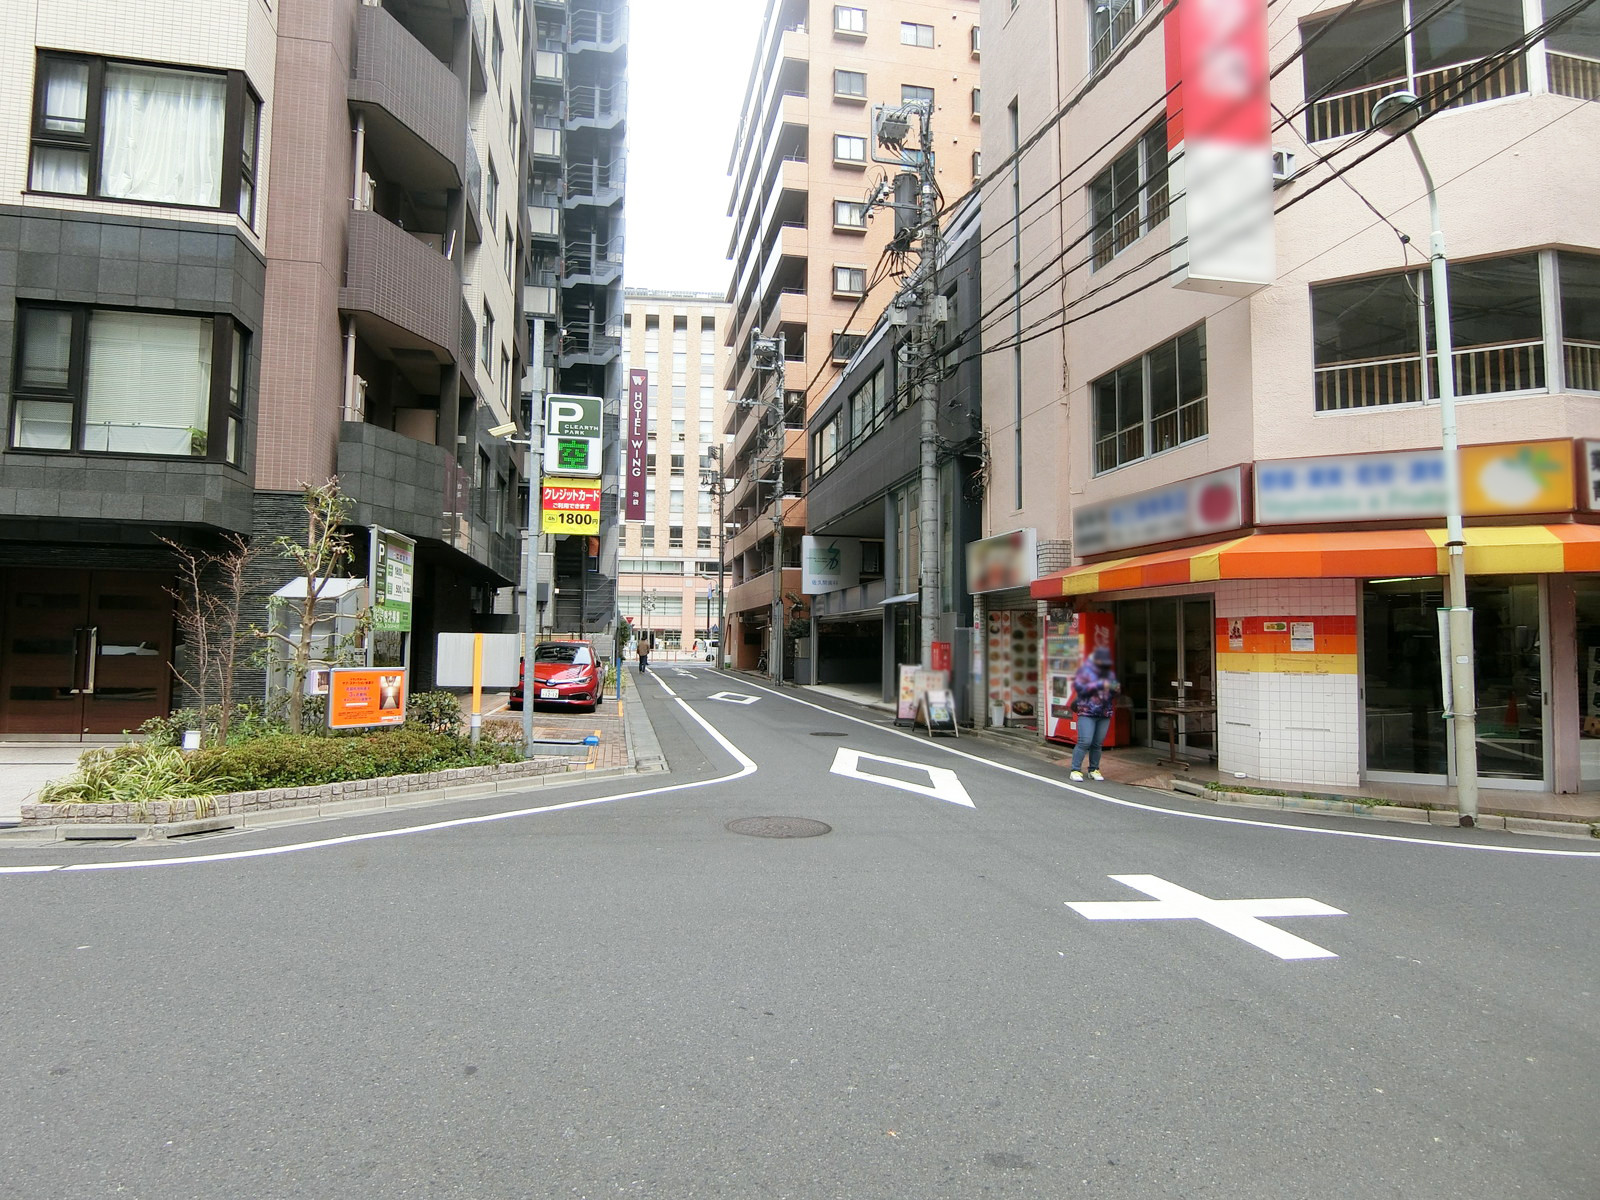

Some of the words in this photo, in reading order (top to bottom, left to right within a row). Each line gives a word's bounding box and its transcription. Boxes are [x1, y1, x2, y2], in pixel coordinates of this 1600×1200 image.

[549, 401, 584, 435] P
[633, 392, 643, 436] HOTEL
[558, 440, 589, 470] 空
[631, 440, 644, 477] WING
[544, 488, 600, 502] クレジットカード
[632, 490, 640, 506] 池袋
[378, 543, 385, 563] P
